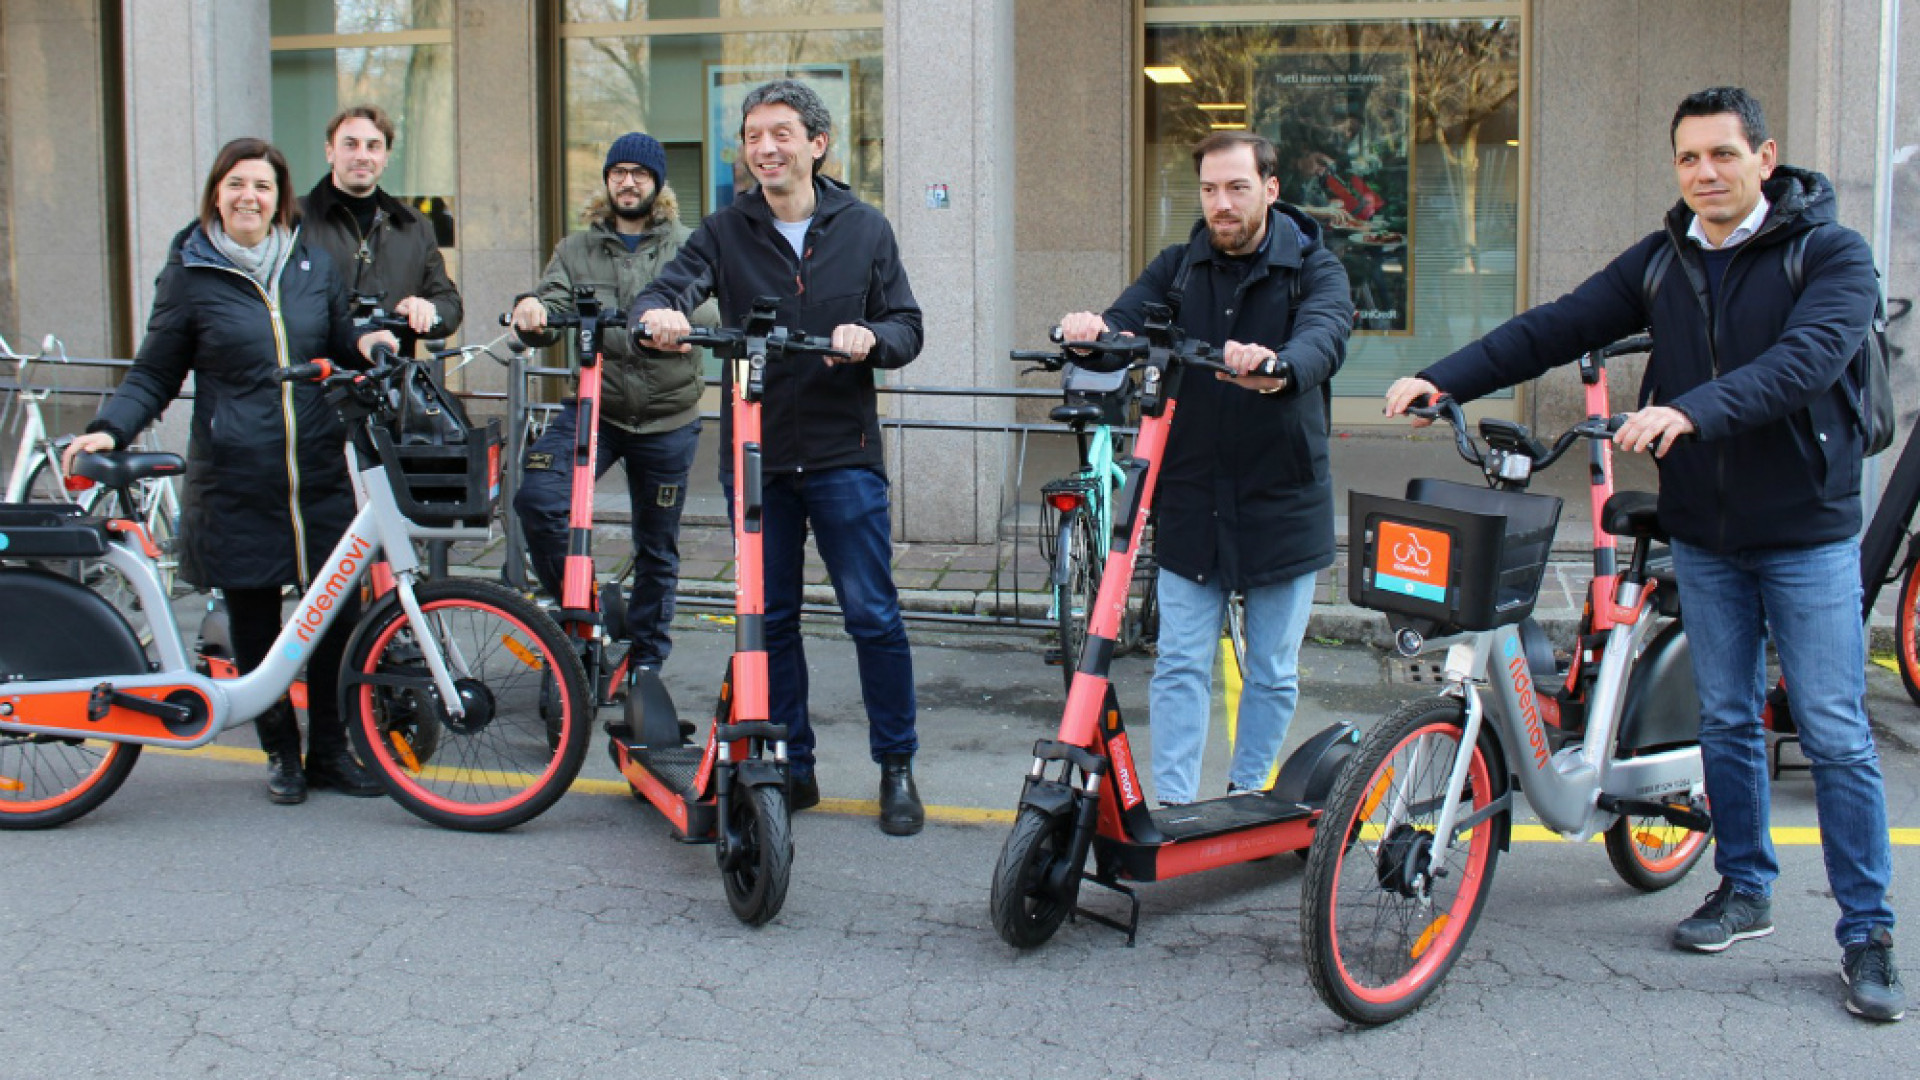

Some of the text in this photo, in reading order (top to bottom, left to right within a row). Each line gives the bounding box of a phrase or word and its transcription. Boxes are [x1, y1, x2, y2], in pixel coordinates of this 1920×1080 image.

[1275, 73, 1299, 84] Tutti
[1301, 73, 1331, 84] hanno
[1332, 74, 1346, 84] un
[1360, 308, 1397, 319] UniCredit
[296, 532, 372, 643] ridemovi
[1508, 656, 1550, 771] ridemovi
